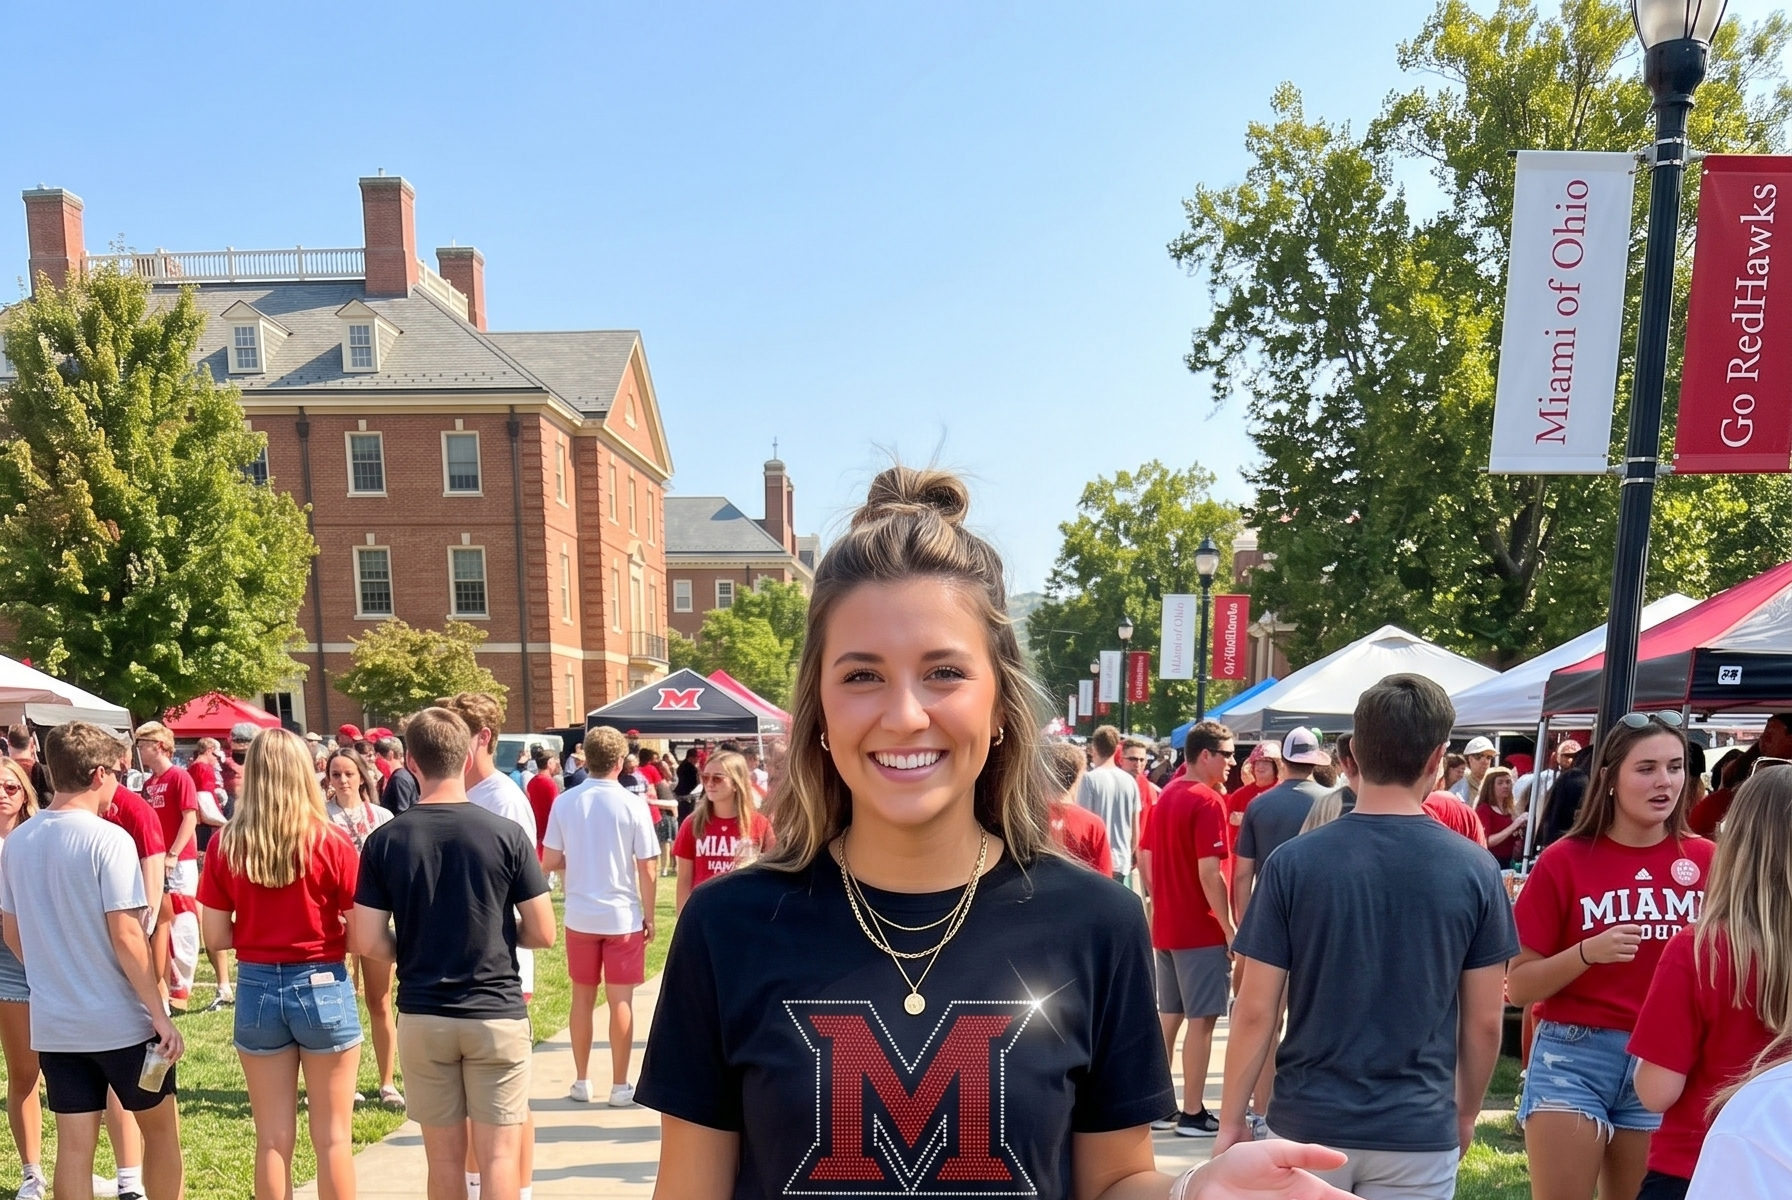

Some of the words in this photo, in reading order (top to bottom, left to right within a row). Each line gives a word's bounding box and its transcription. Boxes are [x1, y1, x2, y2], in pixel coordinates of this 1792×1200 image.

[1551, 179, 1589, 269] Ohio
[1548, 278, 1580, 316] of
[1726, 183, 1777, 383] RedHawks
[1535, 327, 1576, 445] Miami
[1720, 393, 1755, 448] Go
[652, 687, 705, 710] M
[783, 1000, 1037, 1196] M
